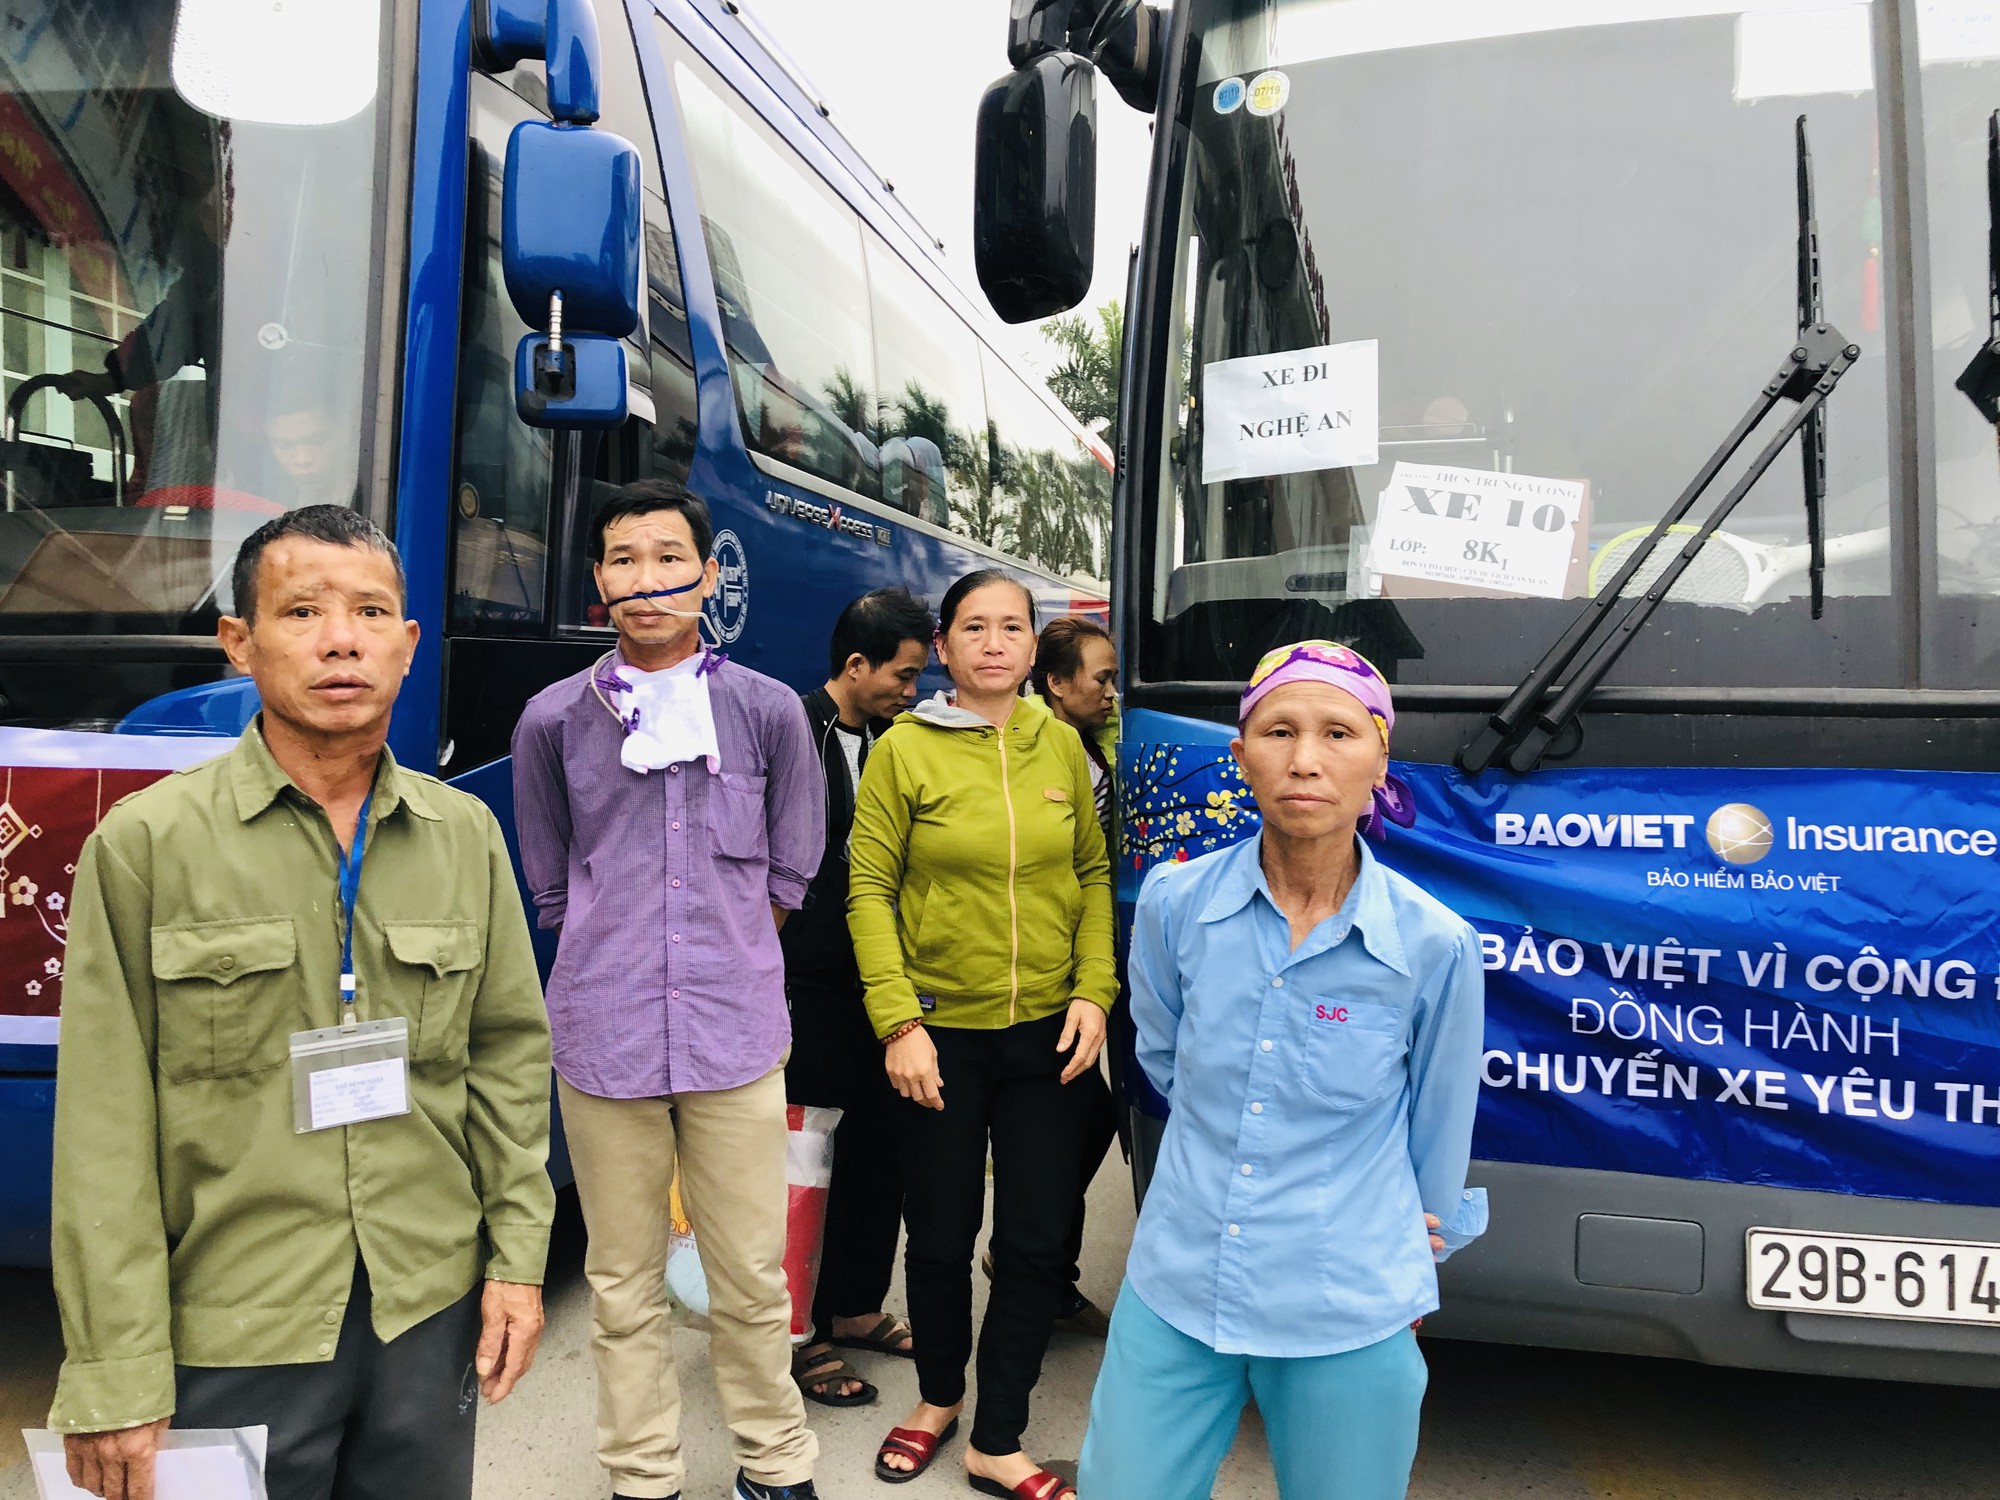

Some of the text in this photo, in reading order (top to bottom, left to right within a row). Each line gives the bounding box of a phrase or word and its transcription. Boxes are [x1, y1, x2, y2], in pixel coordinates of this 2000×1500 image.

[1219, 86, 1240, 100] 07/19
[1254, 85, 1281, 97] 07/19
[1262, 362, 1329, 389] XE ĐI
[1239, 410, 1352, 441] NGHỆ AN
[1399, 485, 1566, 533] XE 10
[1389, 537, 1427, 554] LỚP:
[1494, 812, 1998, 856] BAOVIET Insurance
[1646, 866, 1842, 894] BẢO HIỂM BẢO VIỆT
[1480, 925, 1585, 977] BẢO
[1601, 937, 1722, 990] VIỆT
[1737, 942, 1788, 989] VÌ
[1804, 945, 1977, 1002] CỘNG
[1315, 1004, 1349, 1023] SJC
[1568, 987, 1900, 1057] ĐỒNG HÀNH
[1479, 1048, 1699, 1101] CHUYẾN
[1714, 1067, 1789, 1111] XE
[1801, 1066, 1917, 1120] YÊU
[1761, 1241, 2000, 1314] 29B-614
